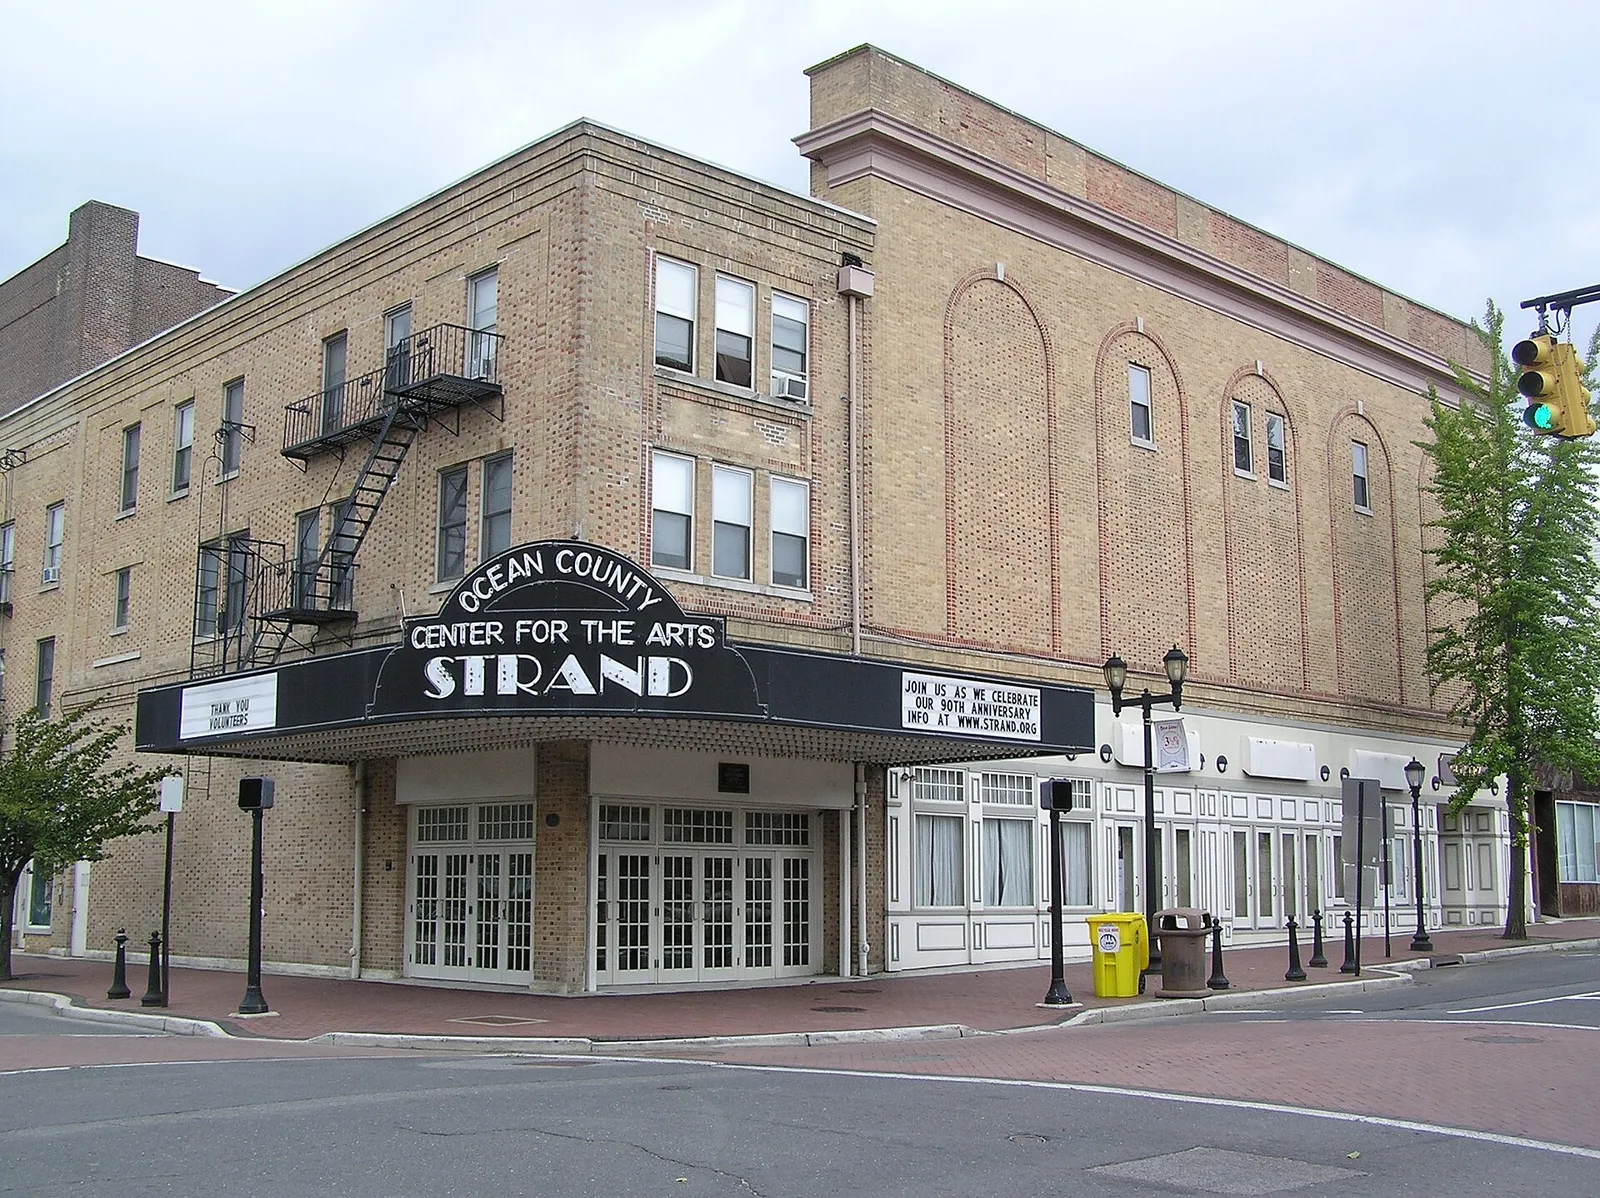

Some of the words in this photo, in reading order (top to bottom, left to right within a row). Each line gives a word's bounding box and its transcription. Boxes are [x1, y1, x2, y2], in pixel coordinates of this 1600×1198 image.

[458, 550, 544, 613] OCEAN
[555, 550, 663, 612] COUNTY
[410, 621, 506, 649] CENTER
[515, 619, 570, 644] FOR
[580, 619, 635, 645] THE
[646, 621, 715, 649] ARTS
[423, 653, 693, 699] STRAND
[904, 680, 927, 694] JOIN
[934, 683, 947, 697] US
[954, 686, 967, 699] AS
[973, 688, 986, 701] WE
[991, 690, 1038, 707] CELEBRATE
[211, 702, 231, 716] THANK
[235, 698, 250, 713] YOU
[915, 696, 934, 710] OUR
[940, 699, 965, 713] 90TH
[971, 702, 1031, 720] ANNIVERSARY
[209, 713, 249, 730] VOLUNTEERS
[908, 710, 929, 724] INFO
[937, 713, 949, 726] AT
[957, 715, 1037, 735] WWW.STRAND.ORG
